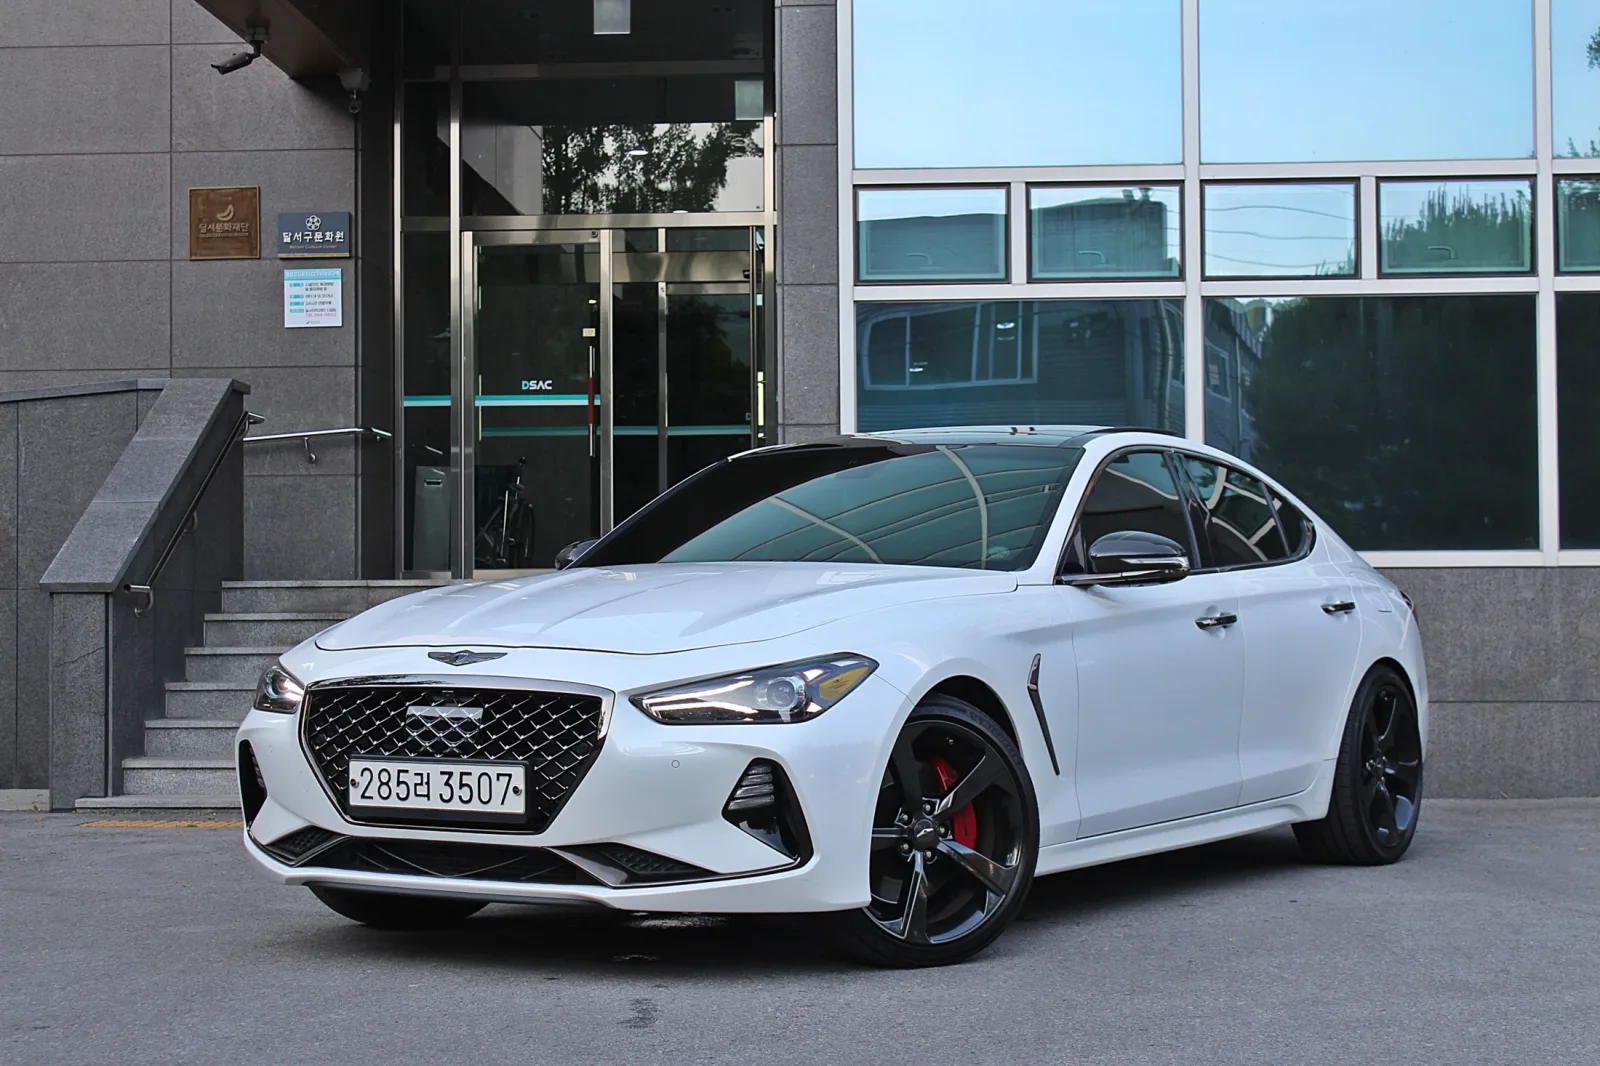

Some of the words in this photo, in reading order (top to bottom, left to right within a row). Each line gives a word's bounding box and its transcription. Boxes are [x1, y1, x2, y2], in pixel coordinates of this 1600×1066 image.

[199, 222, 249, 233] 달서문화재단
[282, 230, 344, 243] 달서구문화원
[521, 380, 552, 390] DSAC
[360, 767, 431, 801] 285러
[438, 770, 513, 805] 3507
